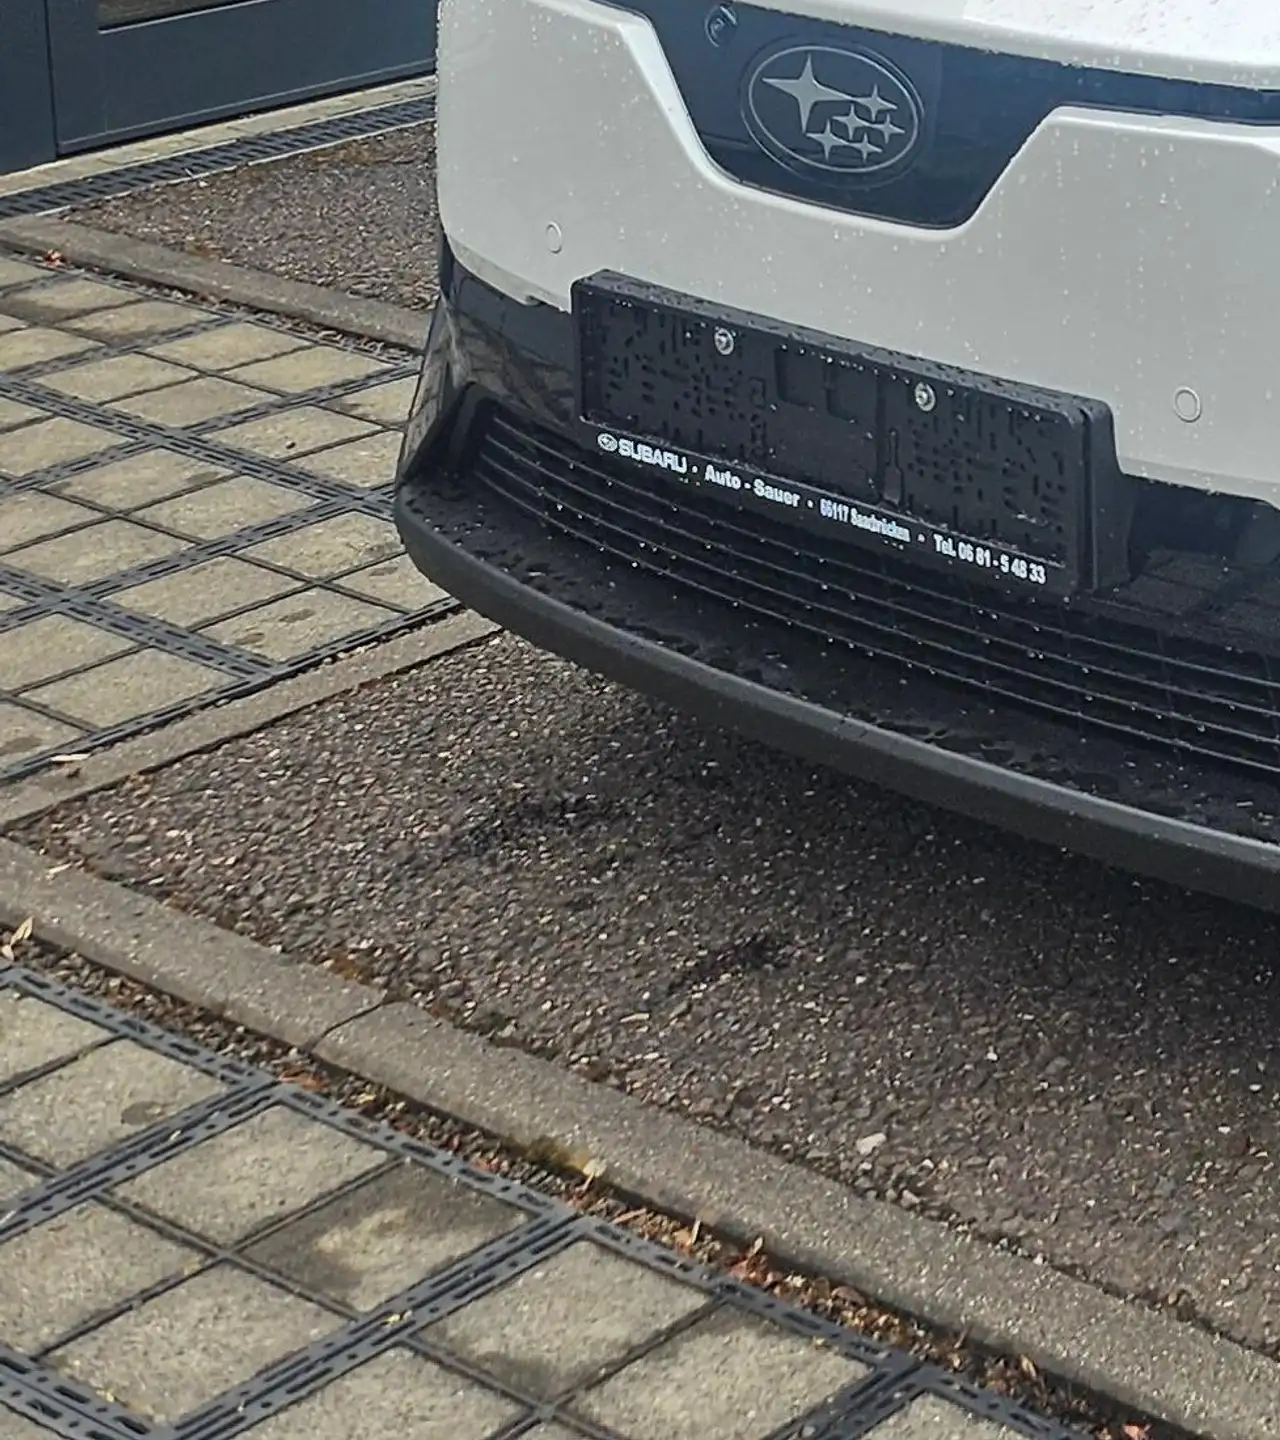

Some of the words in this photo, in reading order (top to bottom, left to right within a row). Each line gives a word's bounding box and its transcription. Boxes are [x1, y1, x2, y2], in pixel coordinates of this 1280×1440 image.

[617, 438, 688, 474] SUBARU
[704, 464, 741, 490] Auto
[752, 478, 801, 508] Sauer
[932, 533, 957, 557] Tel.
